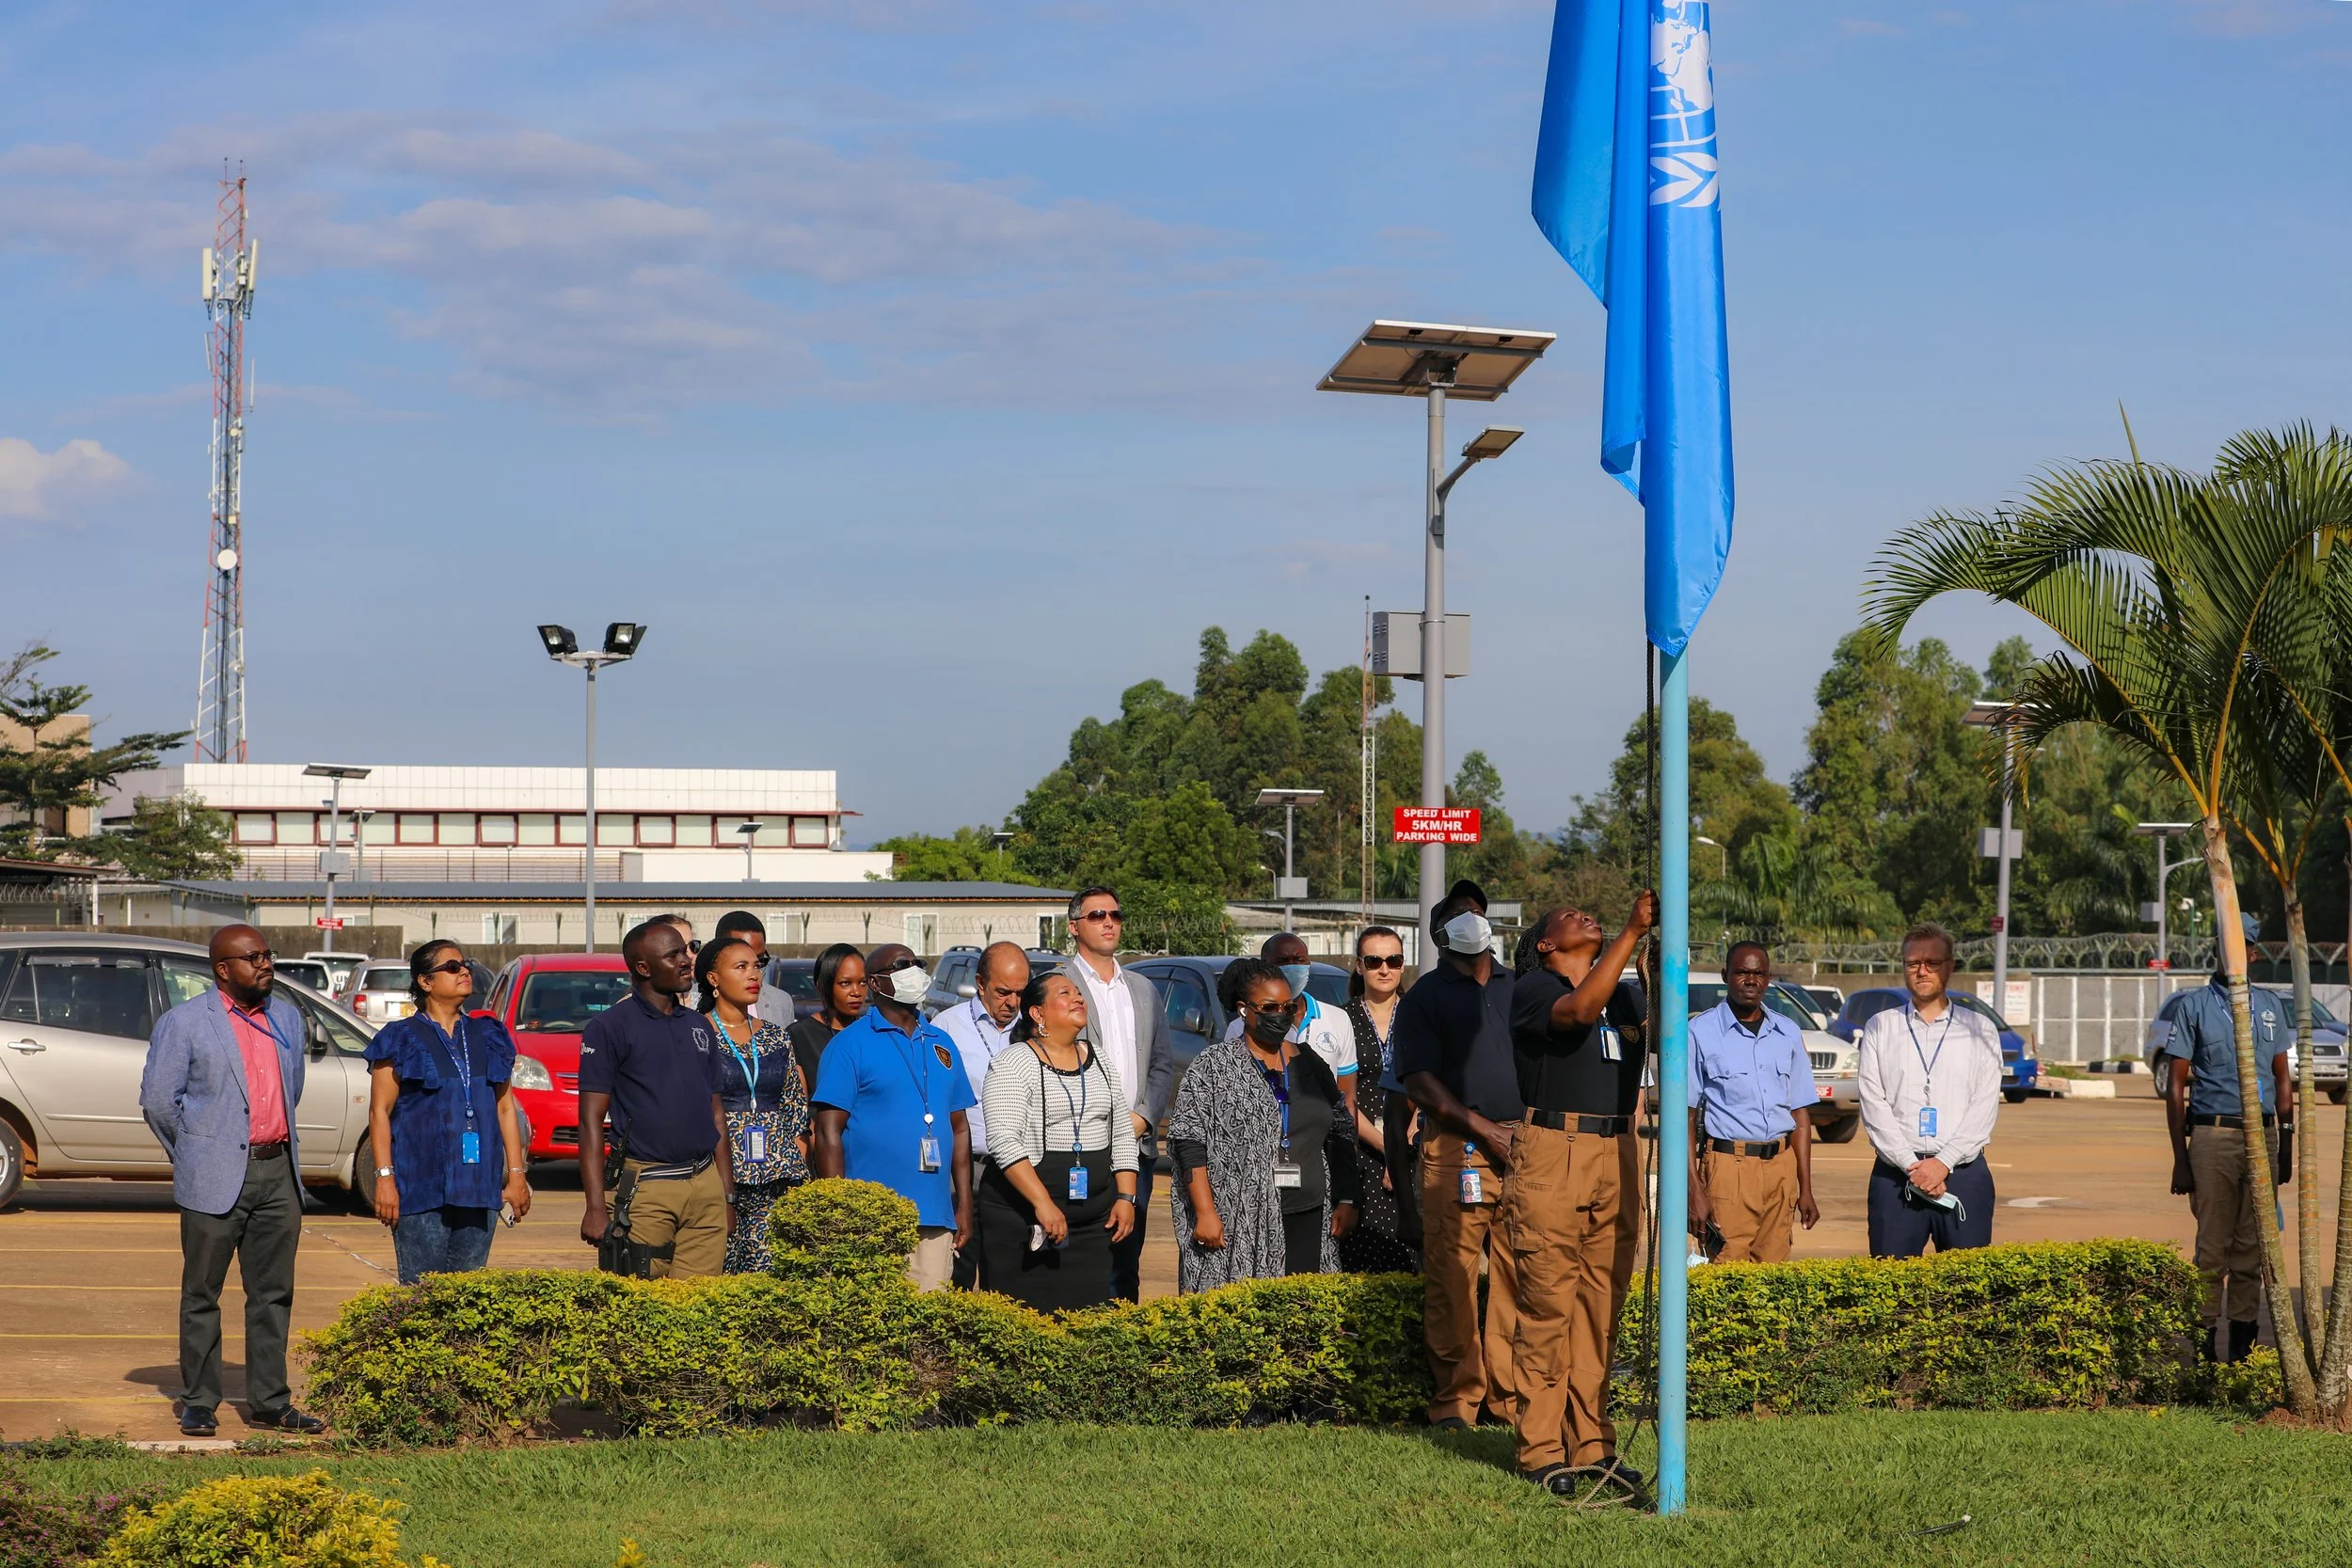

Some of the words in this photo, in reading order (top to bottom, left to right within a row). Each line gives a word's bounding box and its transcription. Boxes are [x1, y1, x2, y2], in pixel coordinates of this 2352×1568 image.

[1403, 809, 1438, 817] SPEED
[1441, 810, 1471, 818] LIMIT
[1411, 820, 1462, 831] 5KM/HR
[1396, 832, 1445, 841] PARKING
[1450, 832, 1477, 841] WIDE
